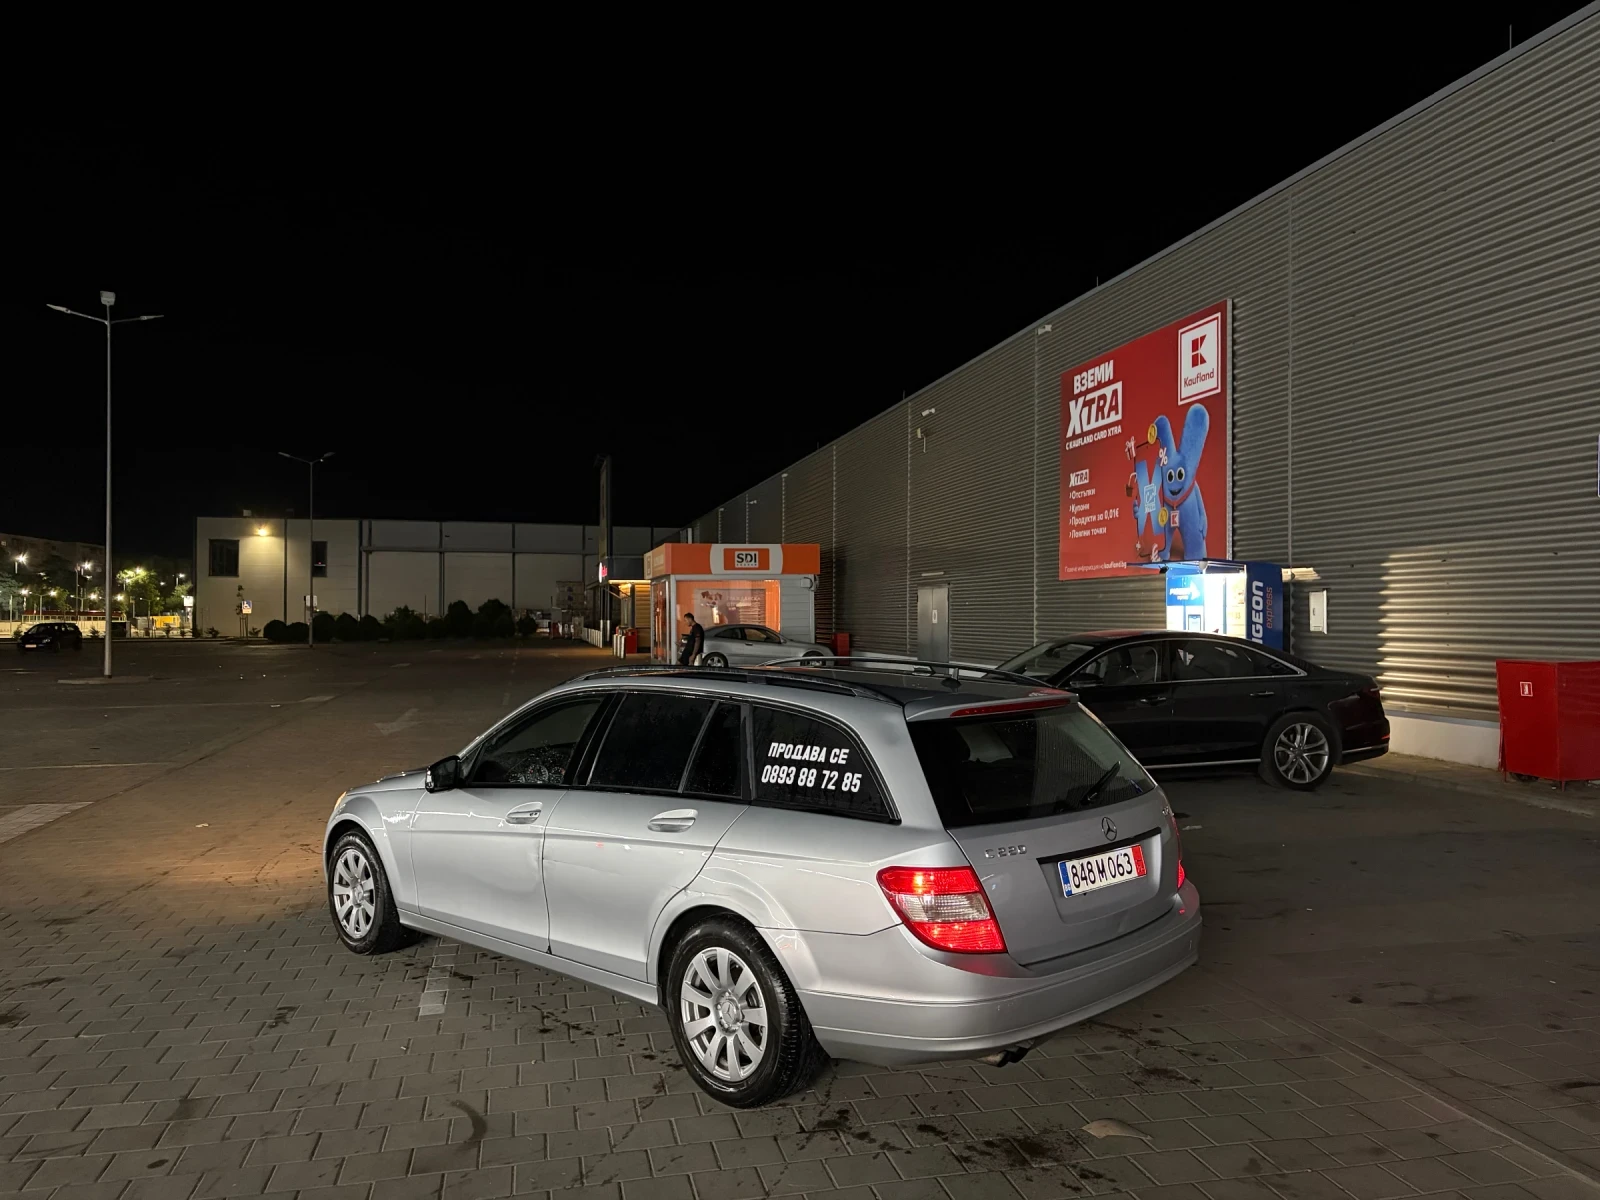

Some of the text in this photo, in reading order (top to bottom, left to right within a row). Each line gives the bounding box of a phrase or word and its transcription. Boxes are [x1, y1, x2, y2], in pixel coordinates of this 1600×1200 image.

[1074, 359, 1114, 395] ВЗЕМИ
[1184, 368, 1214, 388] Kaufland
[1066, 384, 1121, 438] XTRA
[1070, 434, 1093, 449] KAUFLAND
[1094, 429, 1107, 441] CARD
[1107, 425, 1122, 437] XTRA
[1069, 469, 1089, 487] XTRA
[1072, 503, 1089, 514] Купони
[1072, 515, 1096, 527] Продукти
[1104, 508, 1119, 520] 0,01€
[1092, 527, 1106, 536] точки
[737, 553, 757, 563] SDI
[1266, 586, 1275, 629] express
[768, 742, 849, 764] ПРОДАВА СЕ
[761, 765, 862, 792] 0893 88 72 85
[985, 848, 995, 859] C
